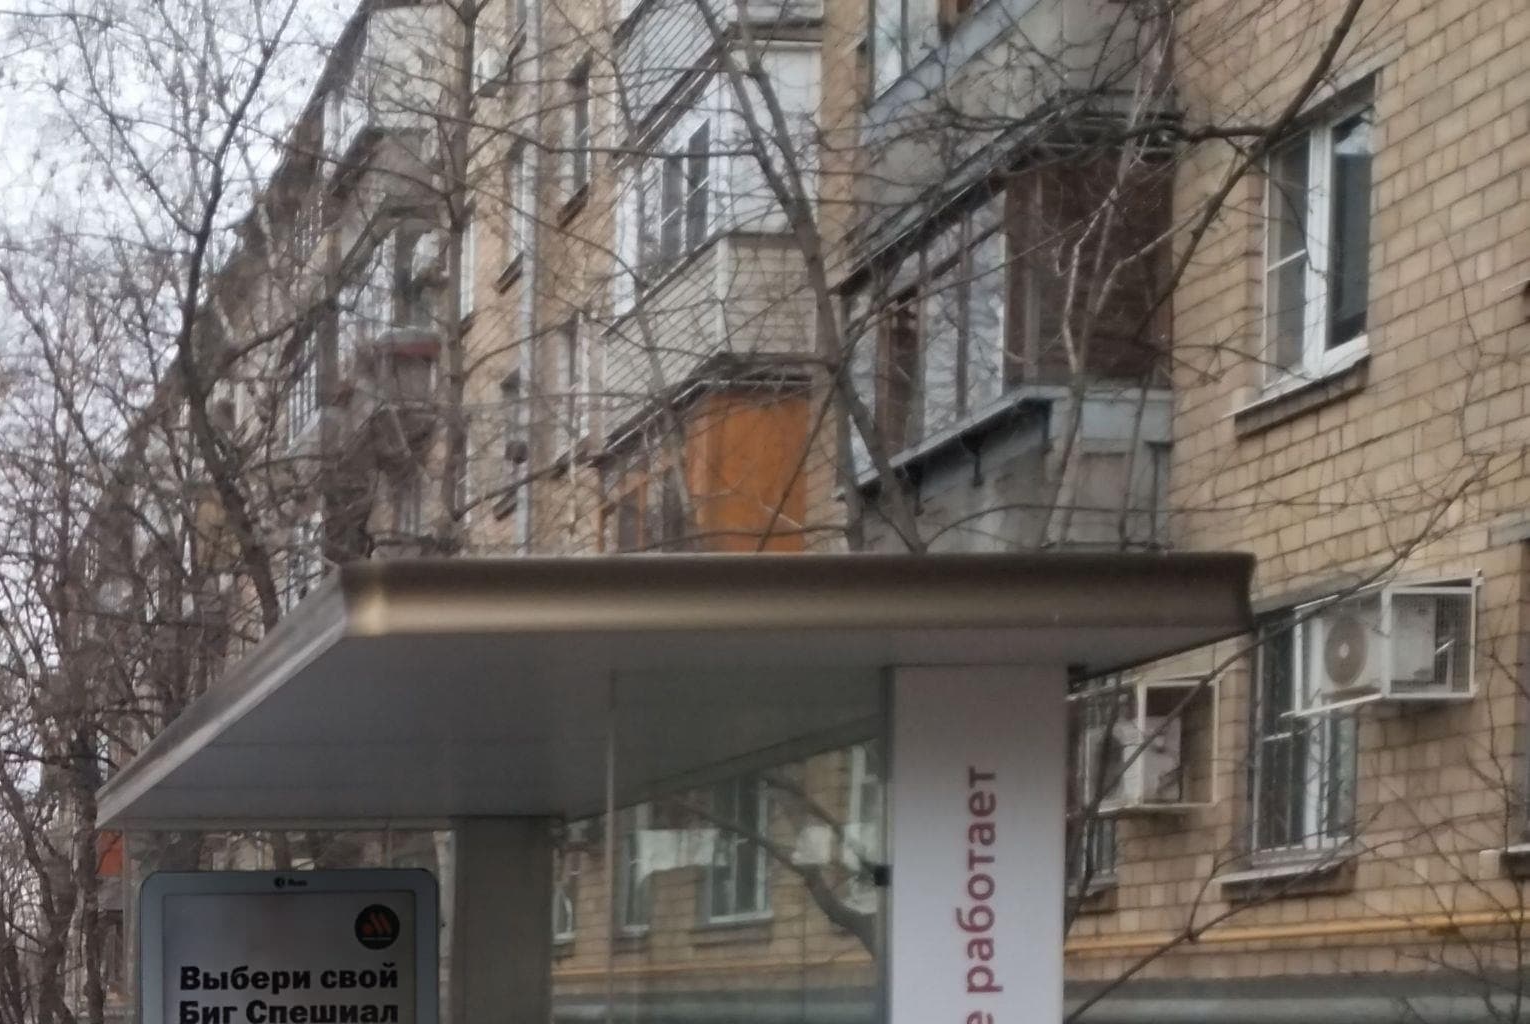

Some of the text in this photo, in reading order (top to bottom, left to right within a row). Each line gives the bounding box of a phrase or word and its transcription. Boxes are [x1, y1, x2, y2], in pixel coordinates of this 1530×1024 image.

[956, 765, 1004, 994] работает
[179, 962, 398, 995] Выбери свой
[179, 999, 399, 1024] Биг Спешиал
